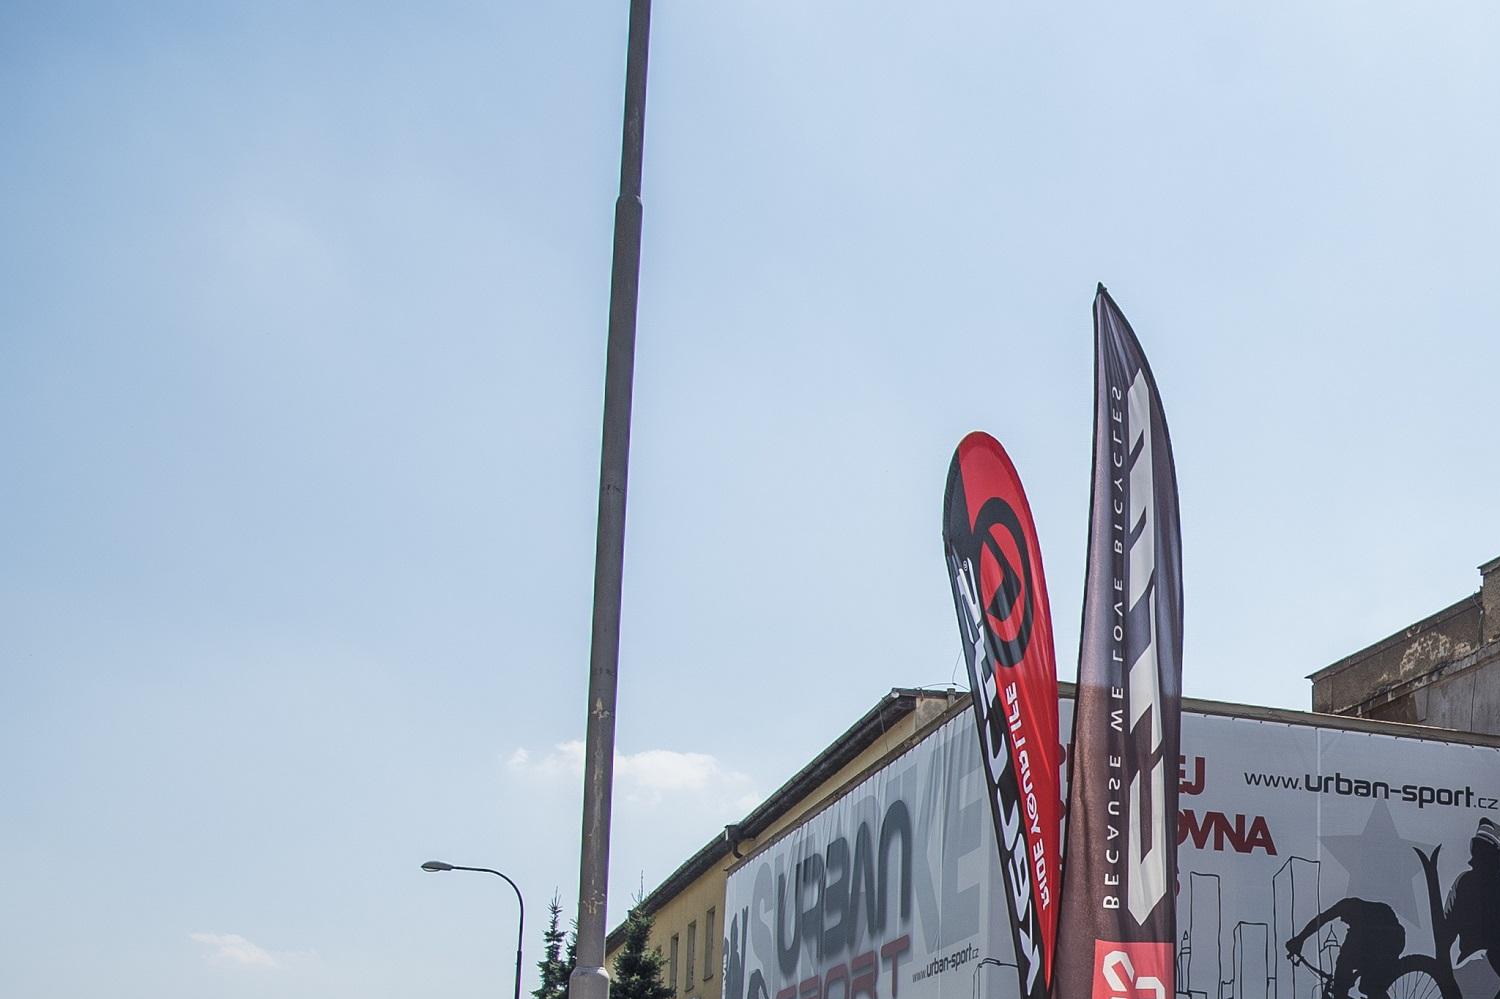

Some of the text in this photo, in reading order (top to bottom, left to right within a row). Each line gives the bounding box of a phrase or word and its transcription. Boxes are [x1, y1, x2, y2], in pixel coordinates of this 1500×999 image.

[1243, 771, 1499, 810] www.urban-sport.cz
[777, 800, 912, 976] URBAN
[912, 943, 980, 984] www.urban-sport.cz
